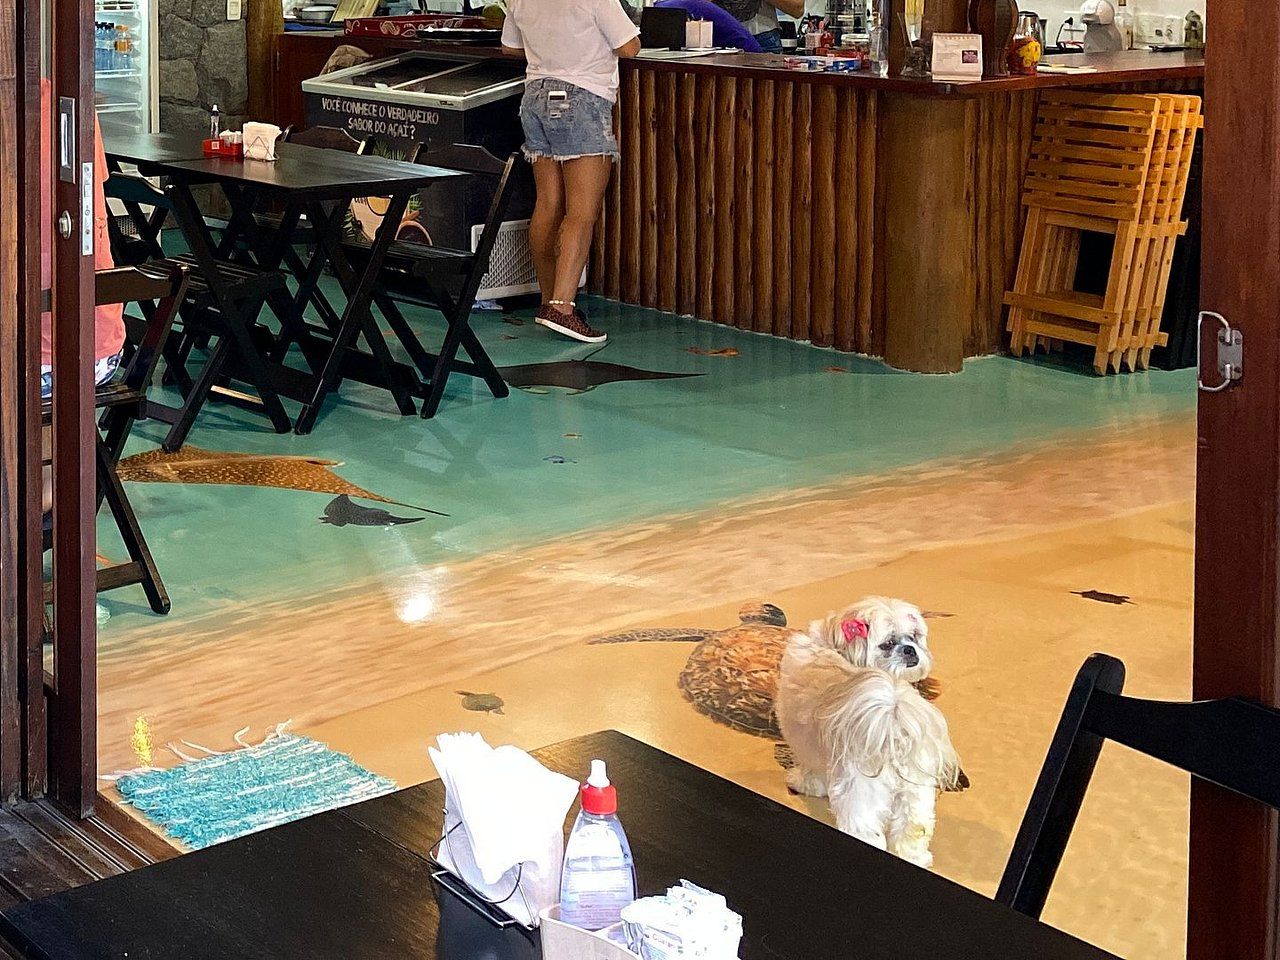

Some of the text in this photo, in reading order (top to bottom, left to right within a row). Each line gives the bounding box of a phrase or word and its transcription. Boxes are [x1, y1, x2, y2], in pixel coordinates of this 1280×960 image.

[322, 97, 439, 125] VOCÊ CONHECE O VERDADEIRO
[348, 117, 373, 133] SABOR
[375, 121, 386, 134] DO
